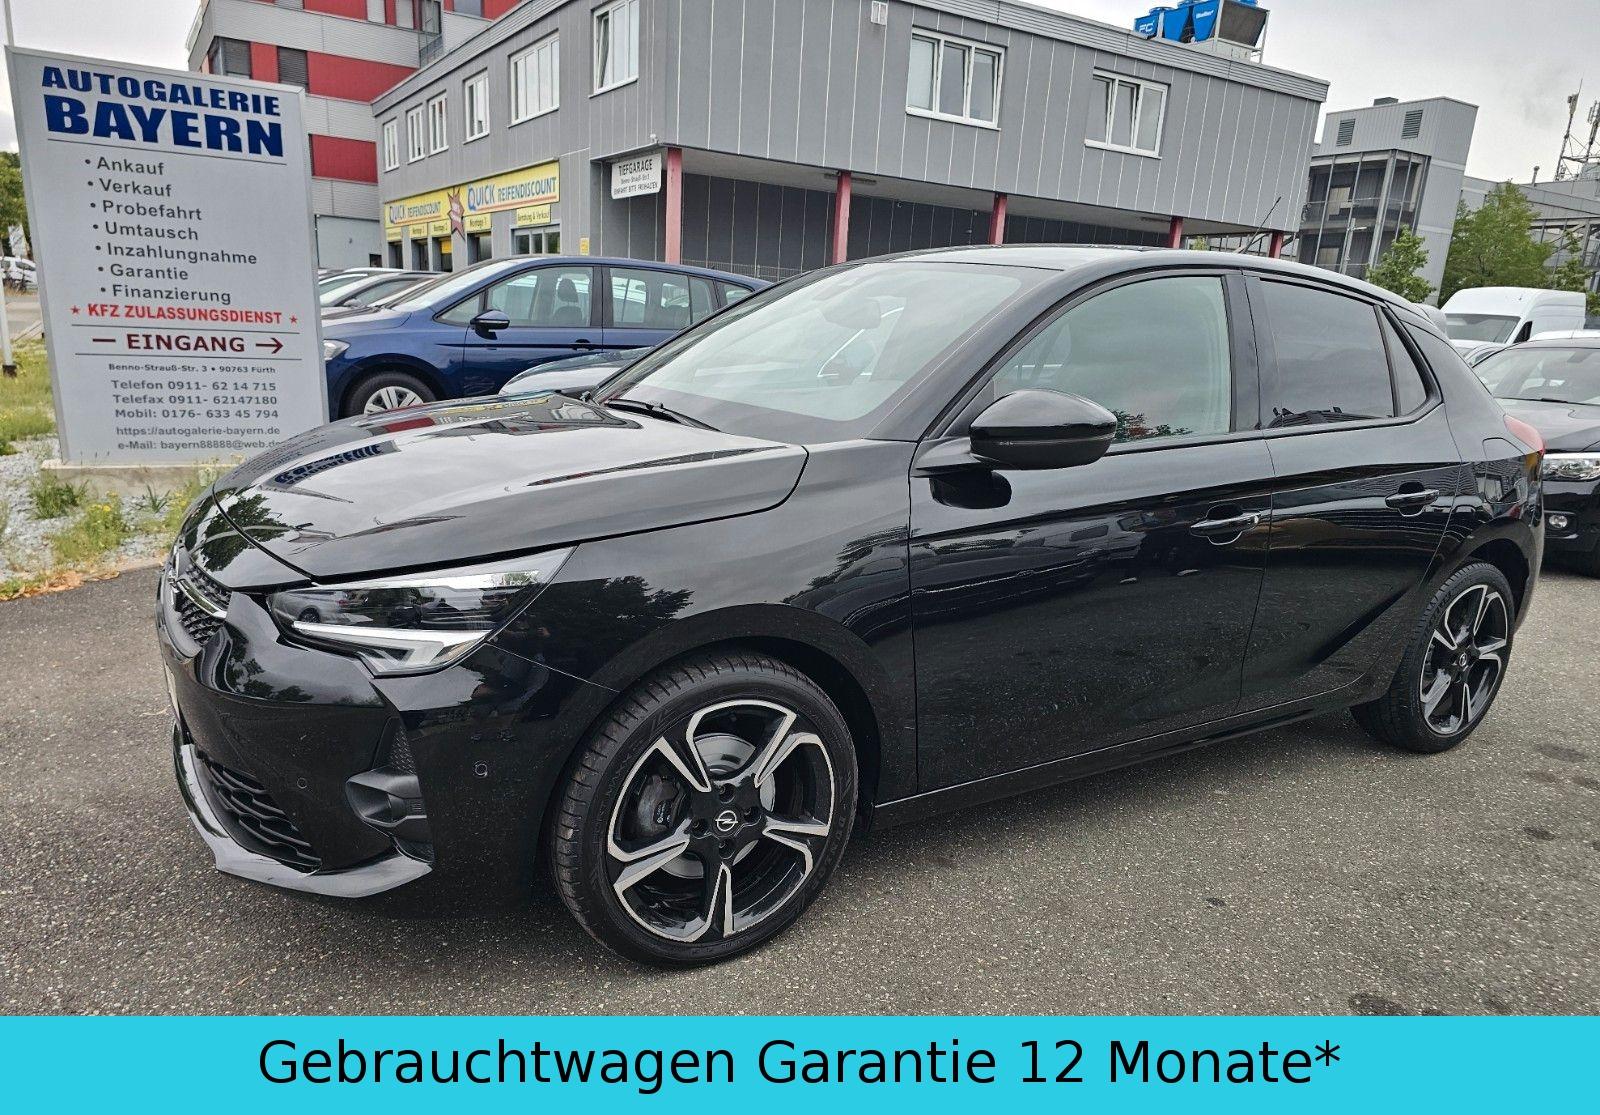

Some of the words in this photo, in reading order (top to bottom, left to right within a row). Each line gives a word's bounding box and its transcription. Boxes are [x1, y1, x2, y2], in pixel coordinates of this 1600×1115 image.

[42, 66, 281, 117] AUTOGALERIE
[43, 94, 283, 157] BAYERN
[97, 156, 164, 176] Ankauf
[99, 177, 172, 197] Verkauf
[467, 184, 496, 212] QUICK
[497, 176, 557, 202] REIFENDISCOUNT
[102, 199, 202, 221] Probefahrt
[105, 221, 199, 241] Umtausch
[107, 242, 257, 264] Inzahlungnahme
[110, 263, 189, 280] Garantie
[112, 284, 232, 305] Finanzierung
[87, 303, 120, 317] KFZ
[124, 305, 282, 324] ZULASSUNGSDIENST
[126, 333, 245, 353] EINGANG
[108, 363, 199, 372] Benno-Strauß-Str.
[201, 365, 207, 373] 3
[251, 366, 276, 374] Fürth
[111, 380, 163, 390] Telefon
[168, 381, 207, 391] 0911-
[212, 381, 228, 391] 62
[233, 382, 248, 391] 14
[252, 382, 276, 391] 715
[113, 394, 165, 404] Telefax
[169, 395, 208, 405] 0911-
[213, 395, 277, 405] 62147180
[115, 408, 157, 418] Mobil:
[162, 409, 201, 419] 0176-
[206, 409, 230, 419] 633
[235, 409, 250, 419] 45
[255, 409, 279, 419] 794
[116, 426, 280, 437] https://autogalerie-bayern.de
[118, 440, 157, 450] e-Mail:
